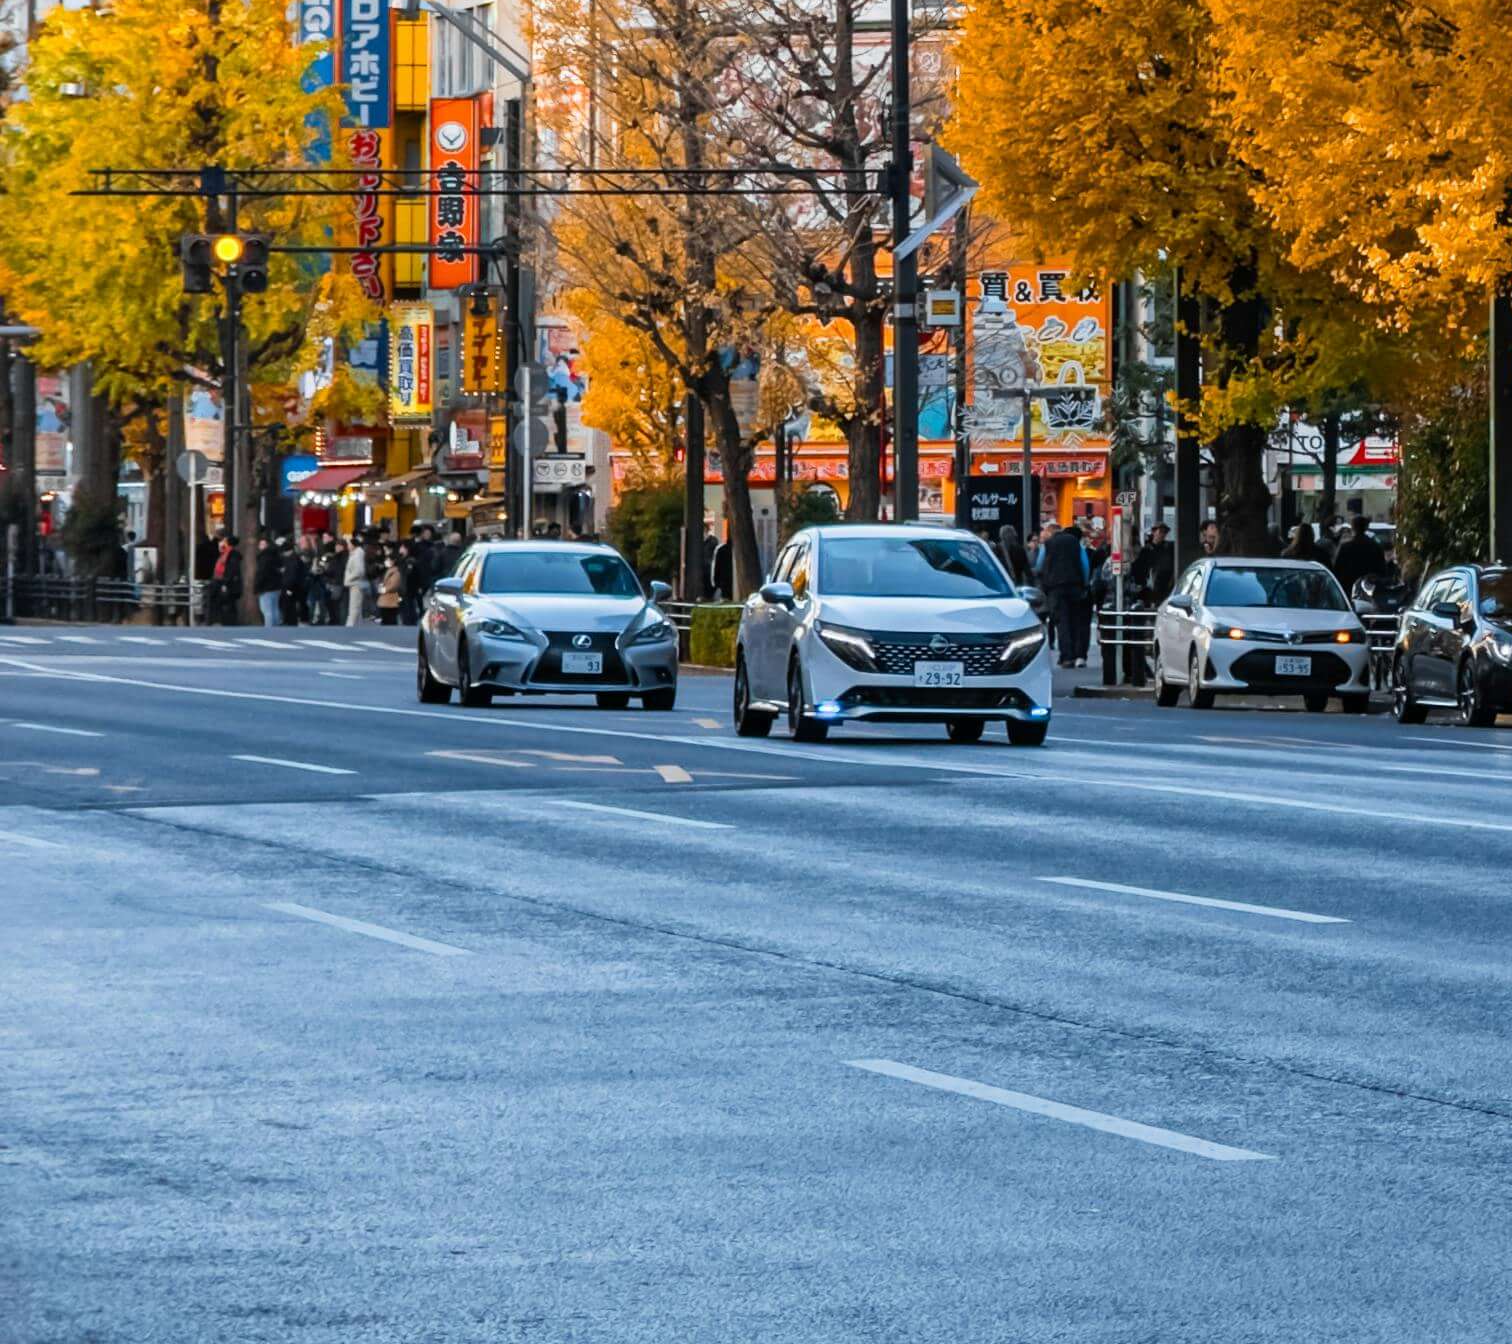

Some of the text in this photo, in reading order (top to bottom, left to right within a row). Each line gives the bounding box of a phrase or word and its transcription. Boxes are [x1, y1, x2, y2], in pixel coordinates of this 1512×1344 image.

[435, 160, 467, 264] 吉野家
[971, 493, 1018, 505] ベルサール
